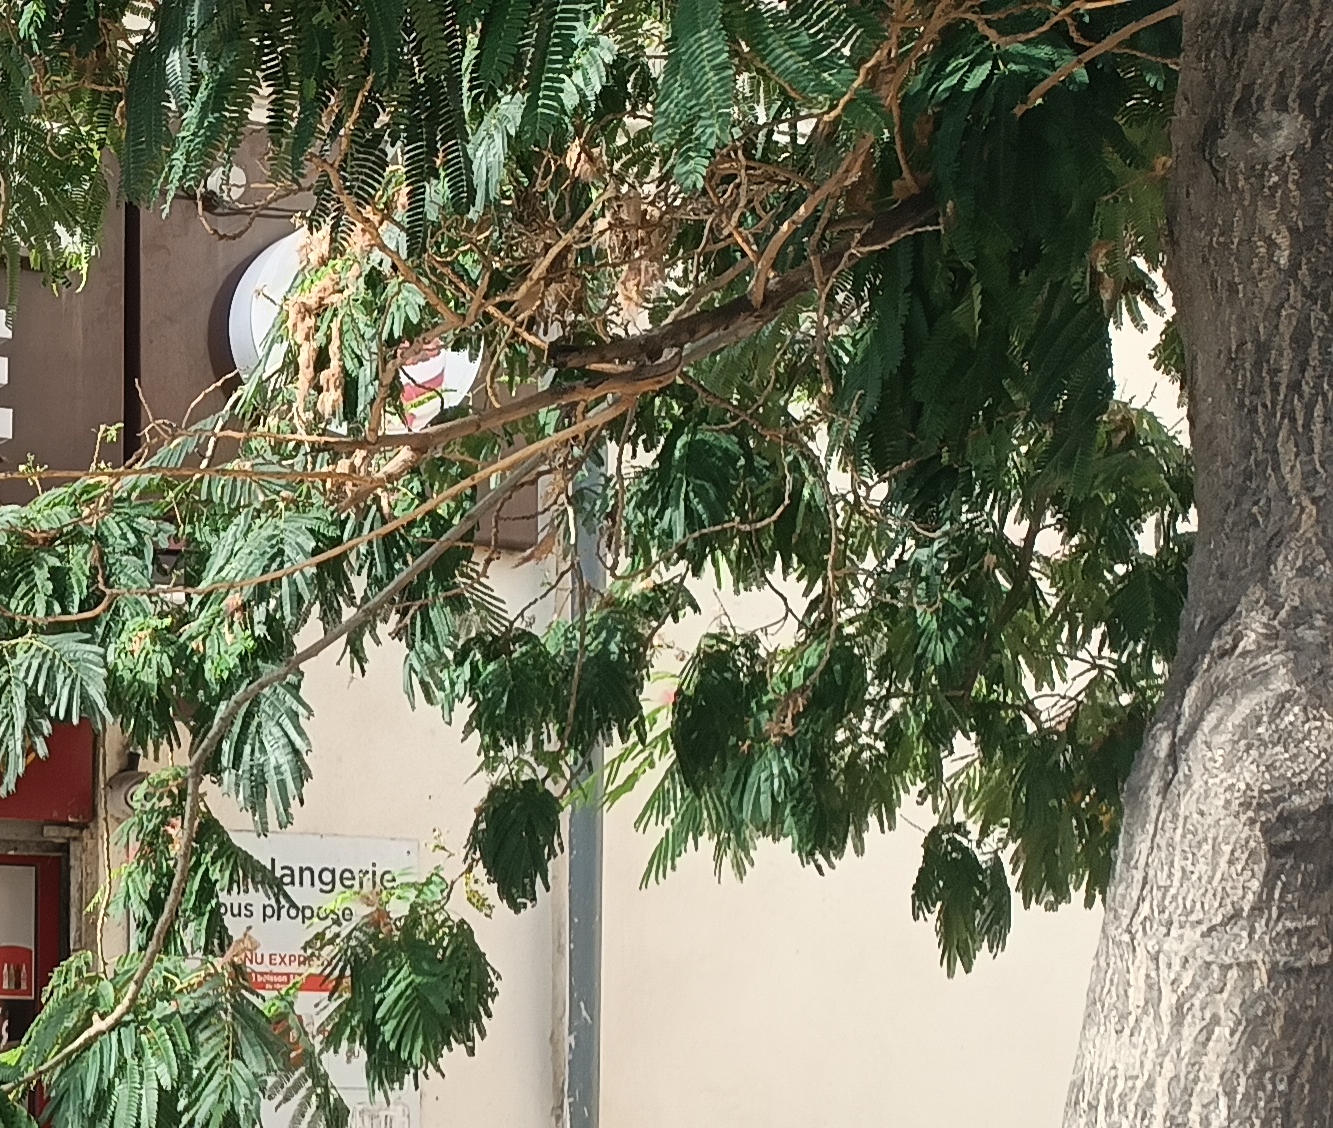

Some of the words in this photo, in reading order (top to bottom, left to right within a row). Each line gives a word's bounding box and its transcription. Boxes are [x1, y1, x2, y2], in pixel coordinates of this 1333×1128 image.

[270, 857, 396, 894] langerie
[219, 902, 254, 918] ous
[244, 953, 264, 965] NU
